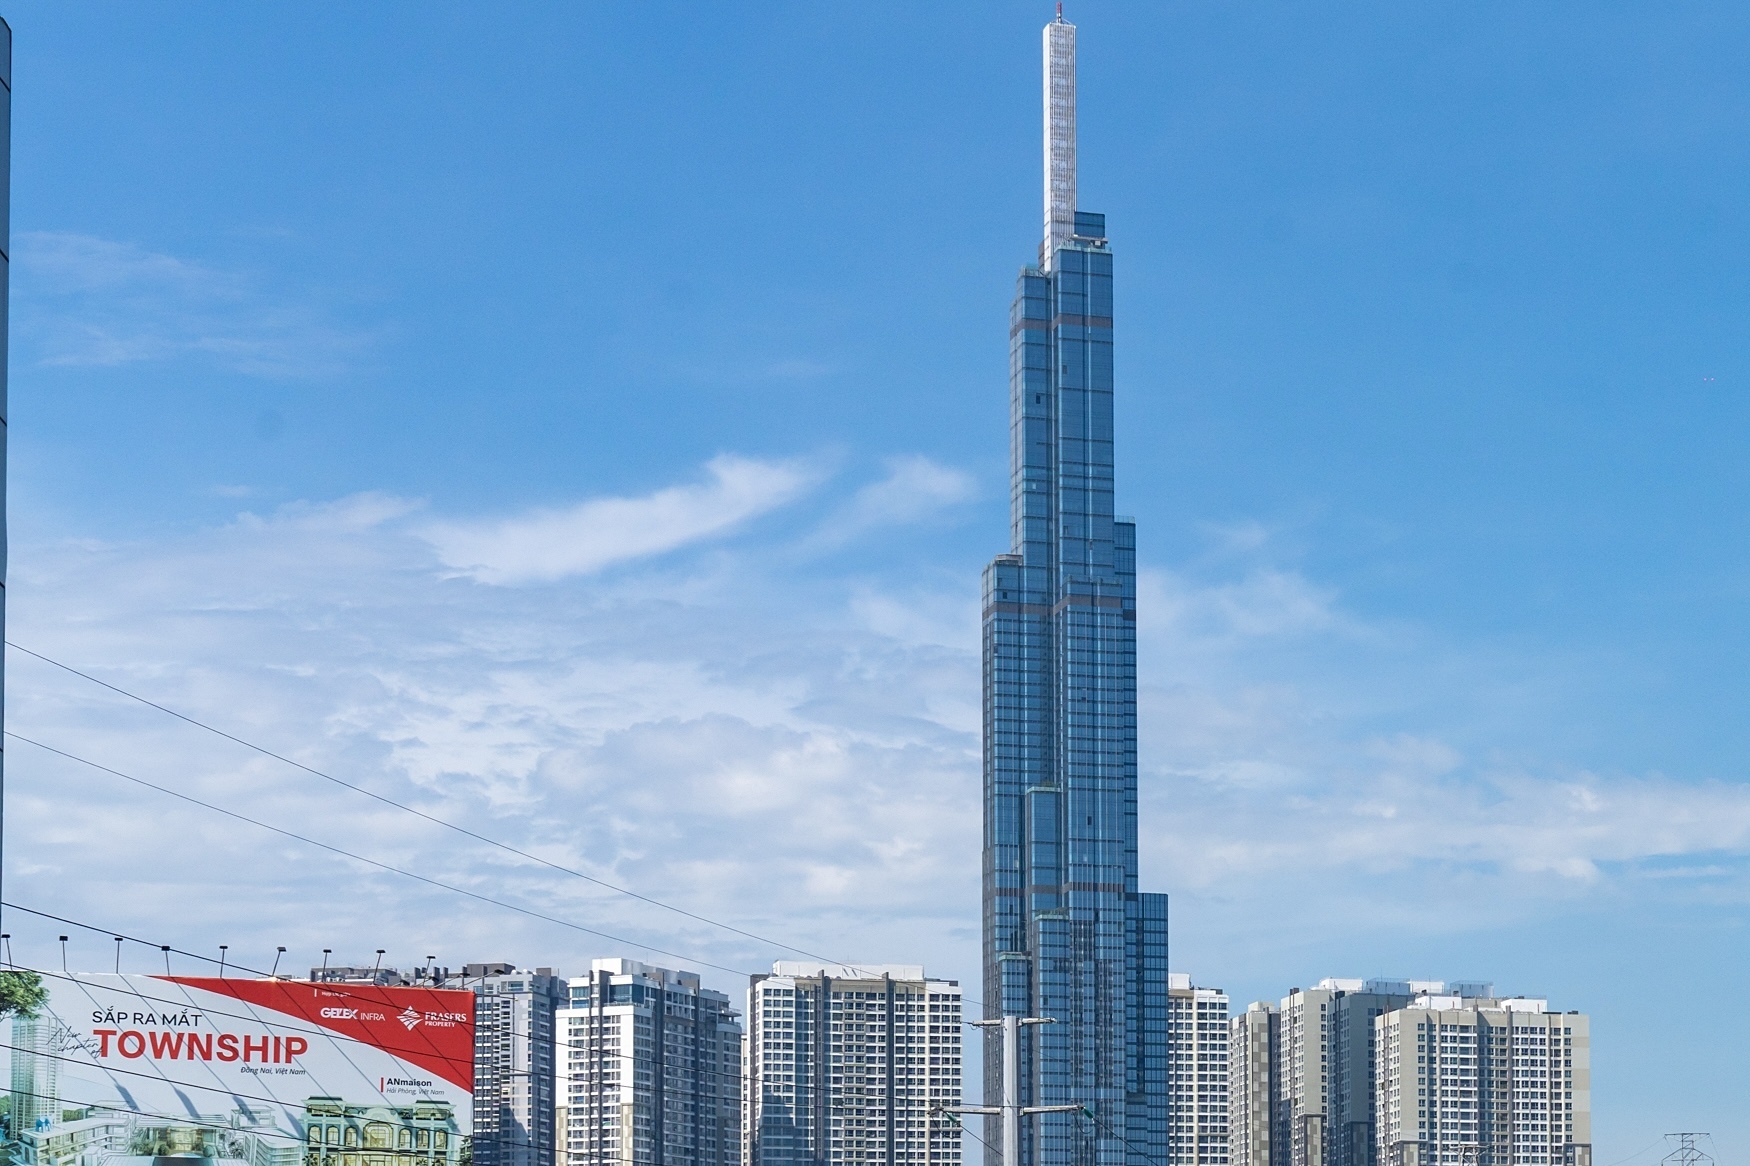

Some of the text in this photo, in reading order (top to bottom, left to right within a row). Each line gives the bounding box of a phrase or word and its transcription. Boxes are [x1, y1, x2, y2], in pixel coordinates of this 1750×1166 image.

[92, 1006, 202, 1027] SẮP RA MẮT
[320, 1007, 385, 1022] GELEX INFRA
[425, 1011, 467, 1022] FRASERS
[93, 1029, 308, 1064] TOWNSHIP
[386, 1078, 432, 1087] ANmaison
